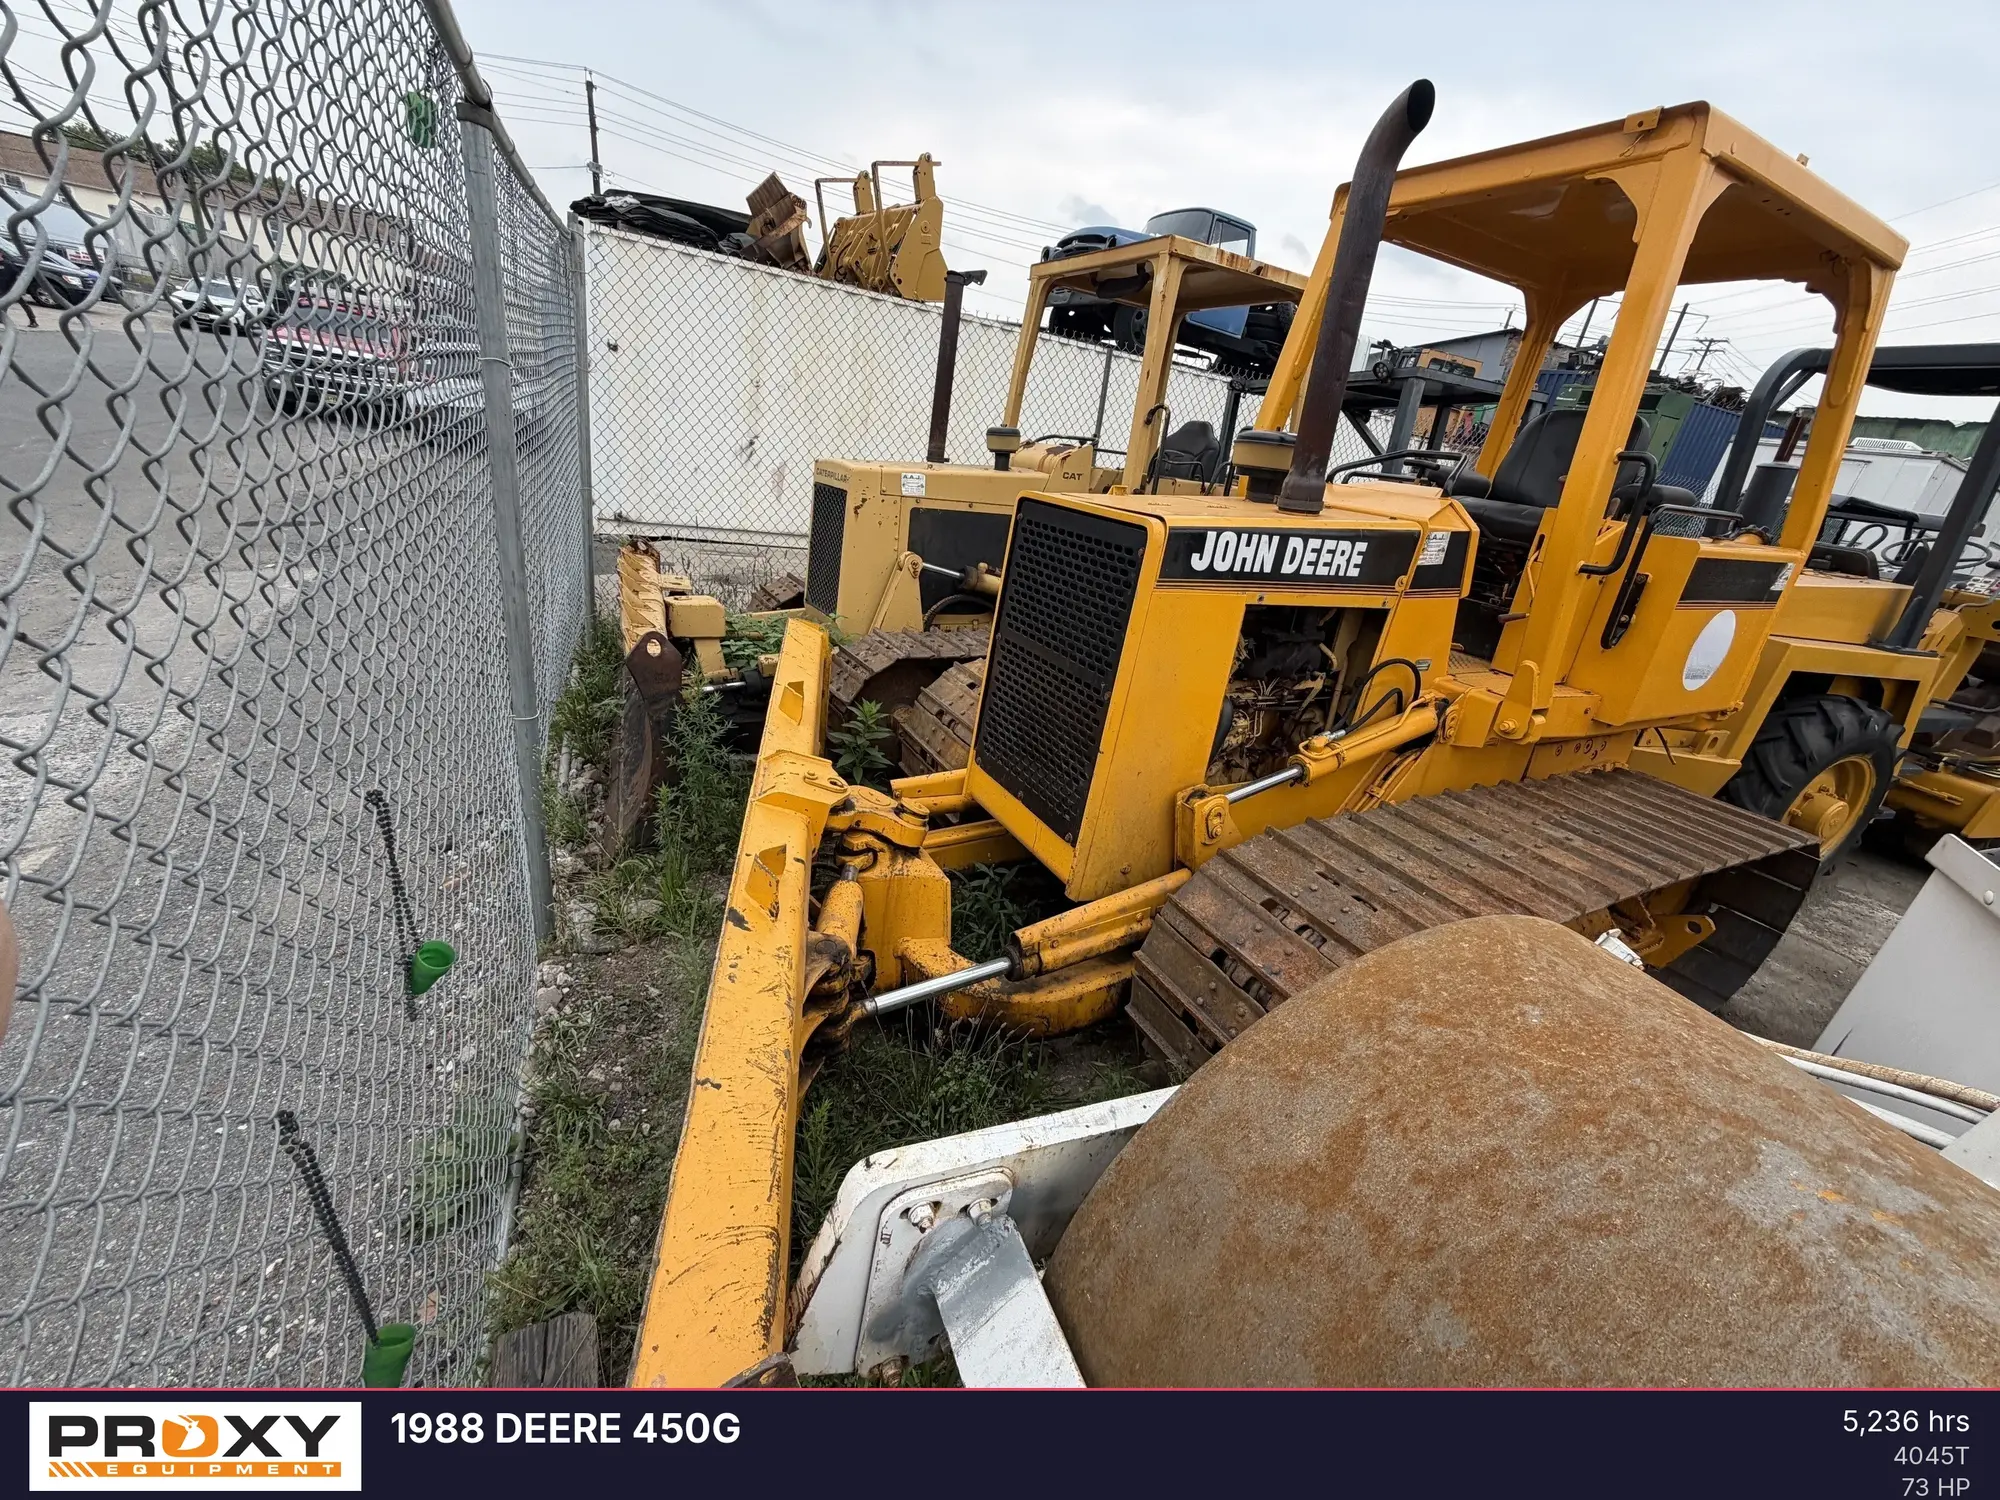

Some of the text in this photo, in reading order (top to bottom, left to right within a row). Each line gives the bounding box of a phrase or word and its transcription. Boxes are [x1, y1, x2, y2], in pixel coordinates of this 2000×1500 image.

[815, 467, 850, 482] CATERPILLAR
[1062, 471, 1083, 481] CAT
[1190, 531, 1369, 578] JOHN DEERE
